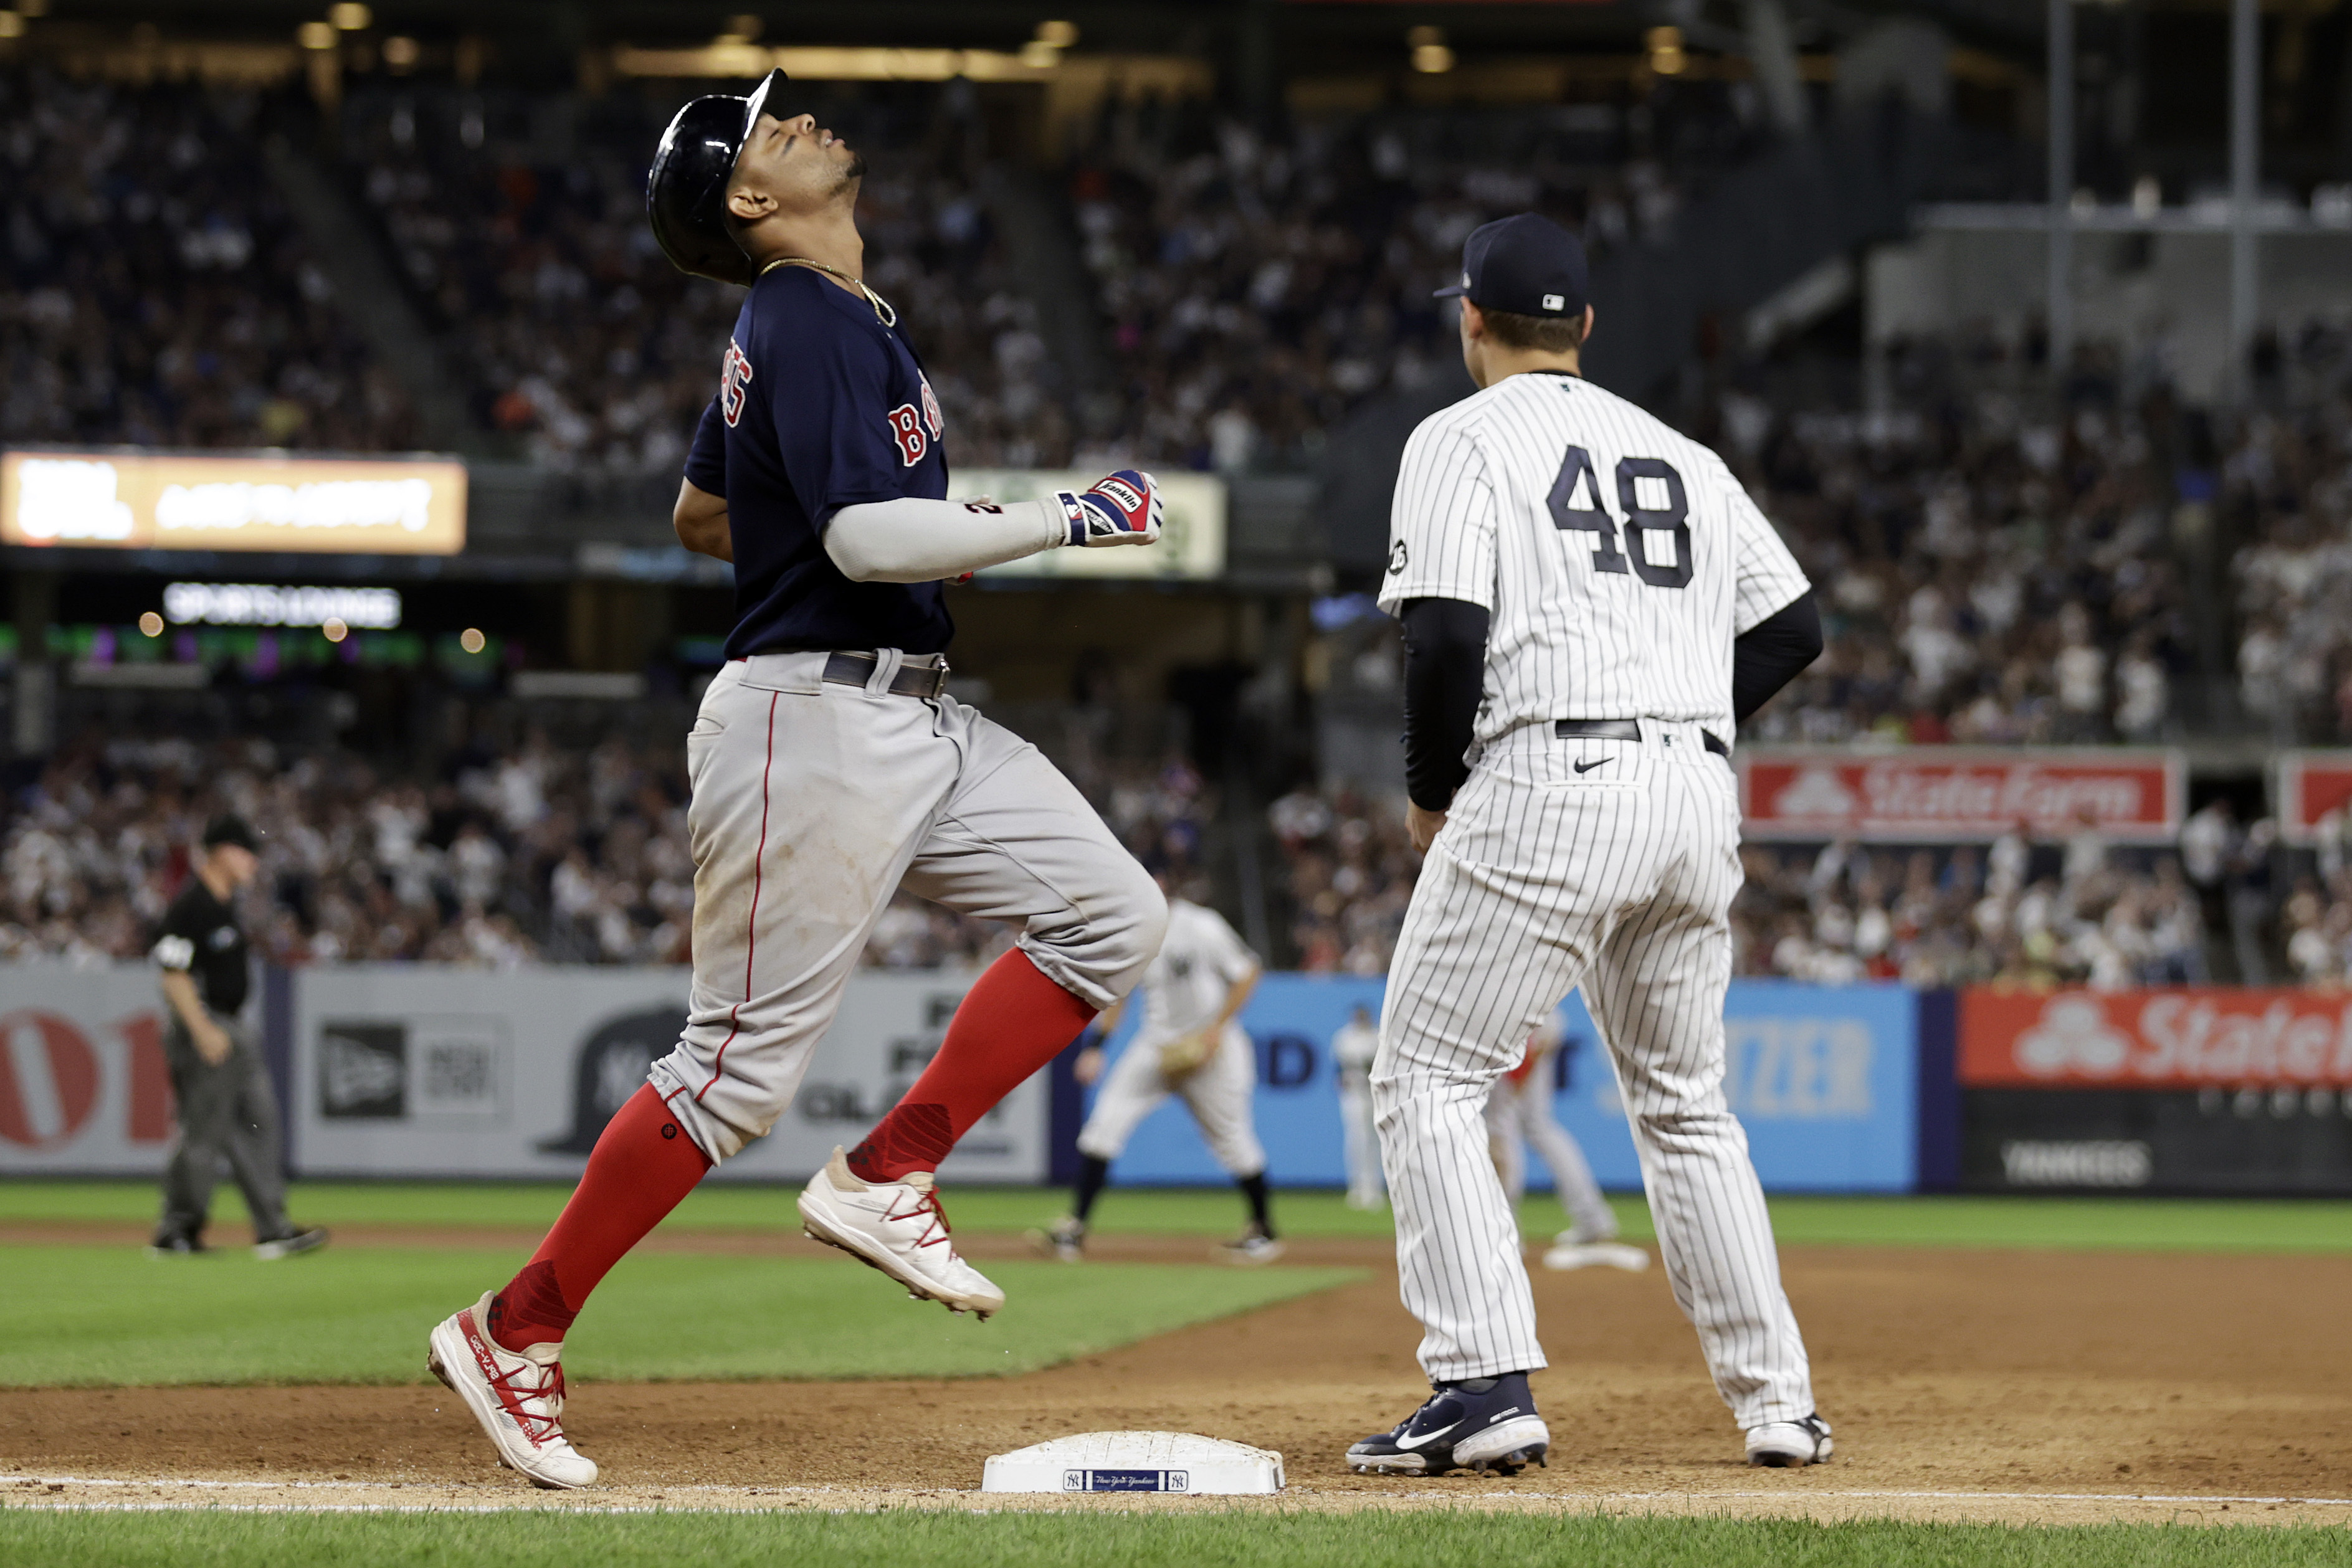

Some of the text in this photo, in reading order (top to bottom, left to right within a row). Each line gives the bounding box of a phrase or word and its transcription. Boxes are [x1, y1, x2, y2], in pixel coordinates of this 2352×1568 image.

[1546, 444, 1693, 589] 48
[2136, 994, 2334, 1081] State
[1096, 1476, 1110, 1484] New
[1128, 1476, 1155, 1488] Yankees
